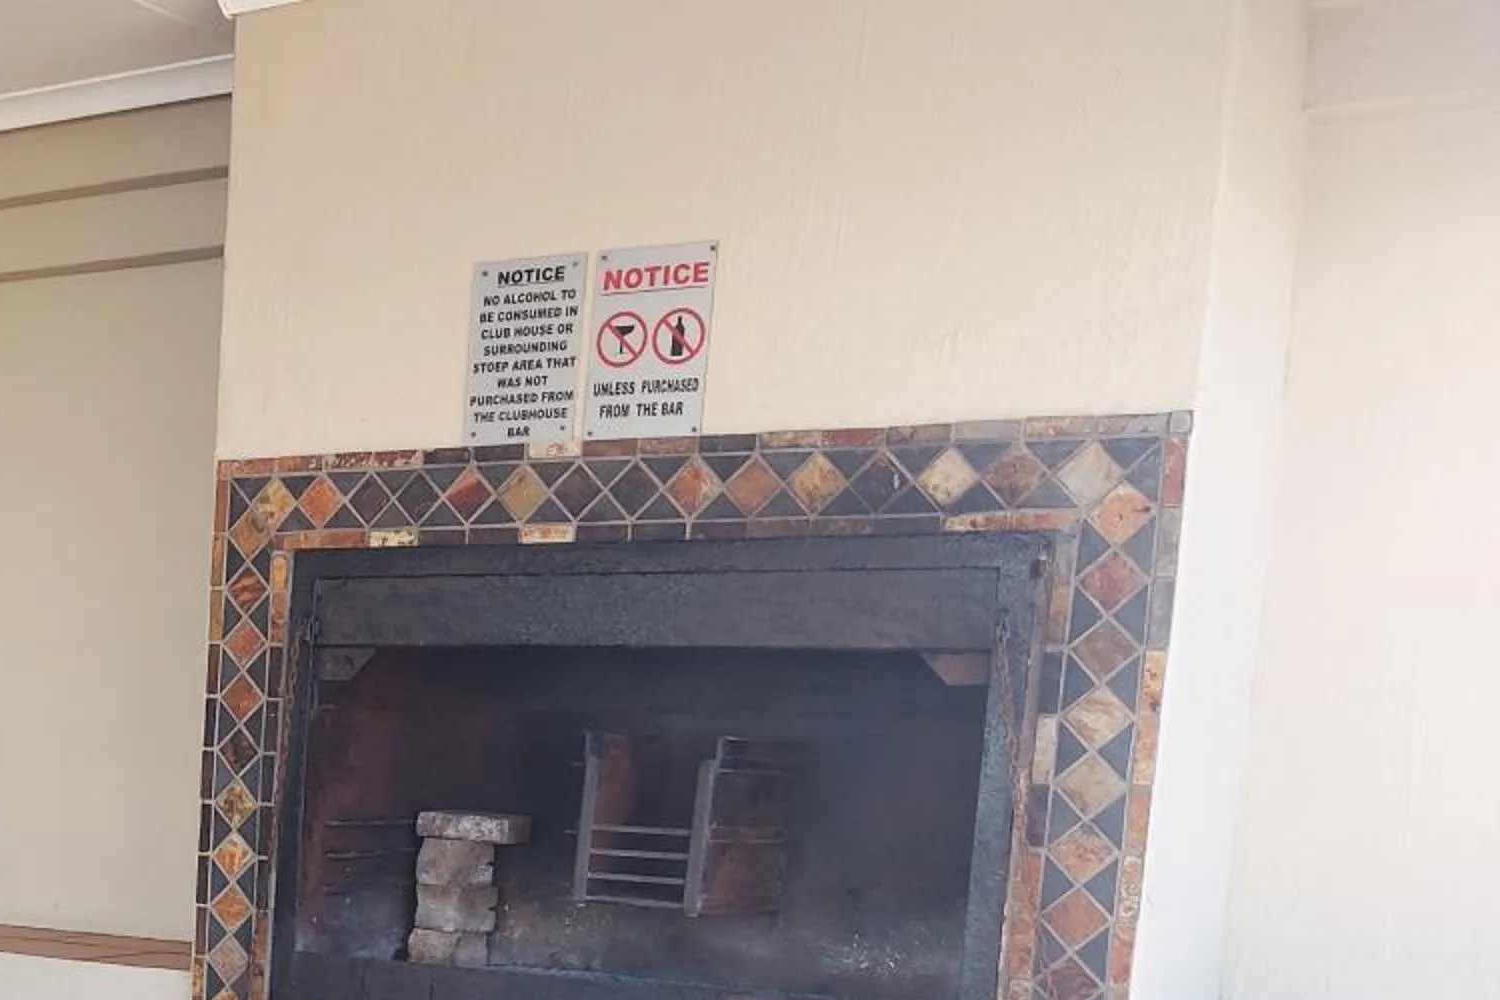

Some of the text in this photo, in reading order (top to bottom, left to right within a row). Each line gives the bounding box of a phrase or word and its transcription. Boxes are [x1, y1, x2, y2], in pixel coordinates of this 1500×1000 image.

[498, 266, 566, 285] NOTICE
[603, 262, 709, 290] NOTICE
[484, 289, 577, 307] NO ALCOHOL TO
[480, 306, 578, 323] BE CONSUMED IN
[481, 323, 573, 340] CLUB HOUSE OR
[484, 340, 568, 356] SURROUNDING
[473, 357, 576, 373] STOEP AREA THAT
[497, 376, 548, 388] WAS NOT
[593, 378, 699, 396] UNLESS PURCHASED
[470, 391, 574, 406] PURCHASED FROM
[474, 408, 568, 423] THE CLUBHOUSE
[599, 402, 683, 418] FROM THE BAR
[507, 427, 530, 437] BAR
